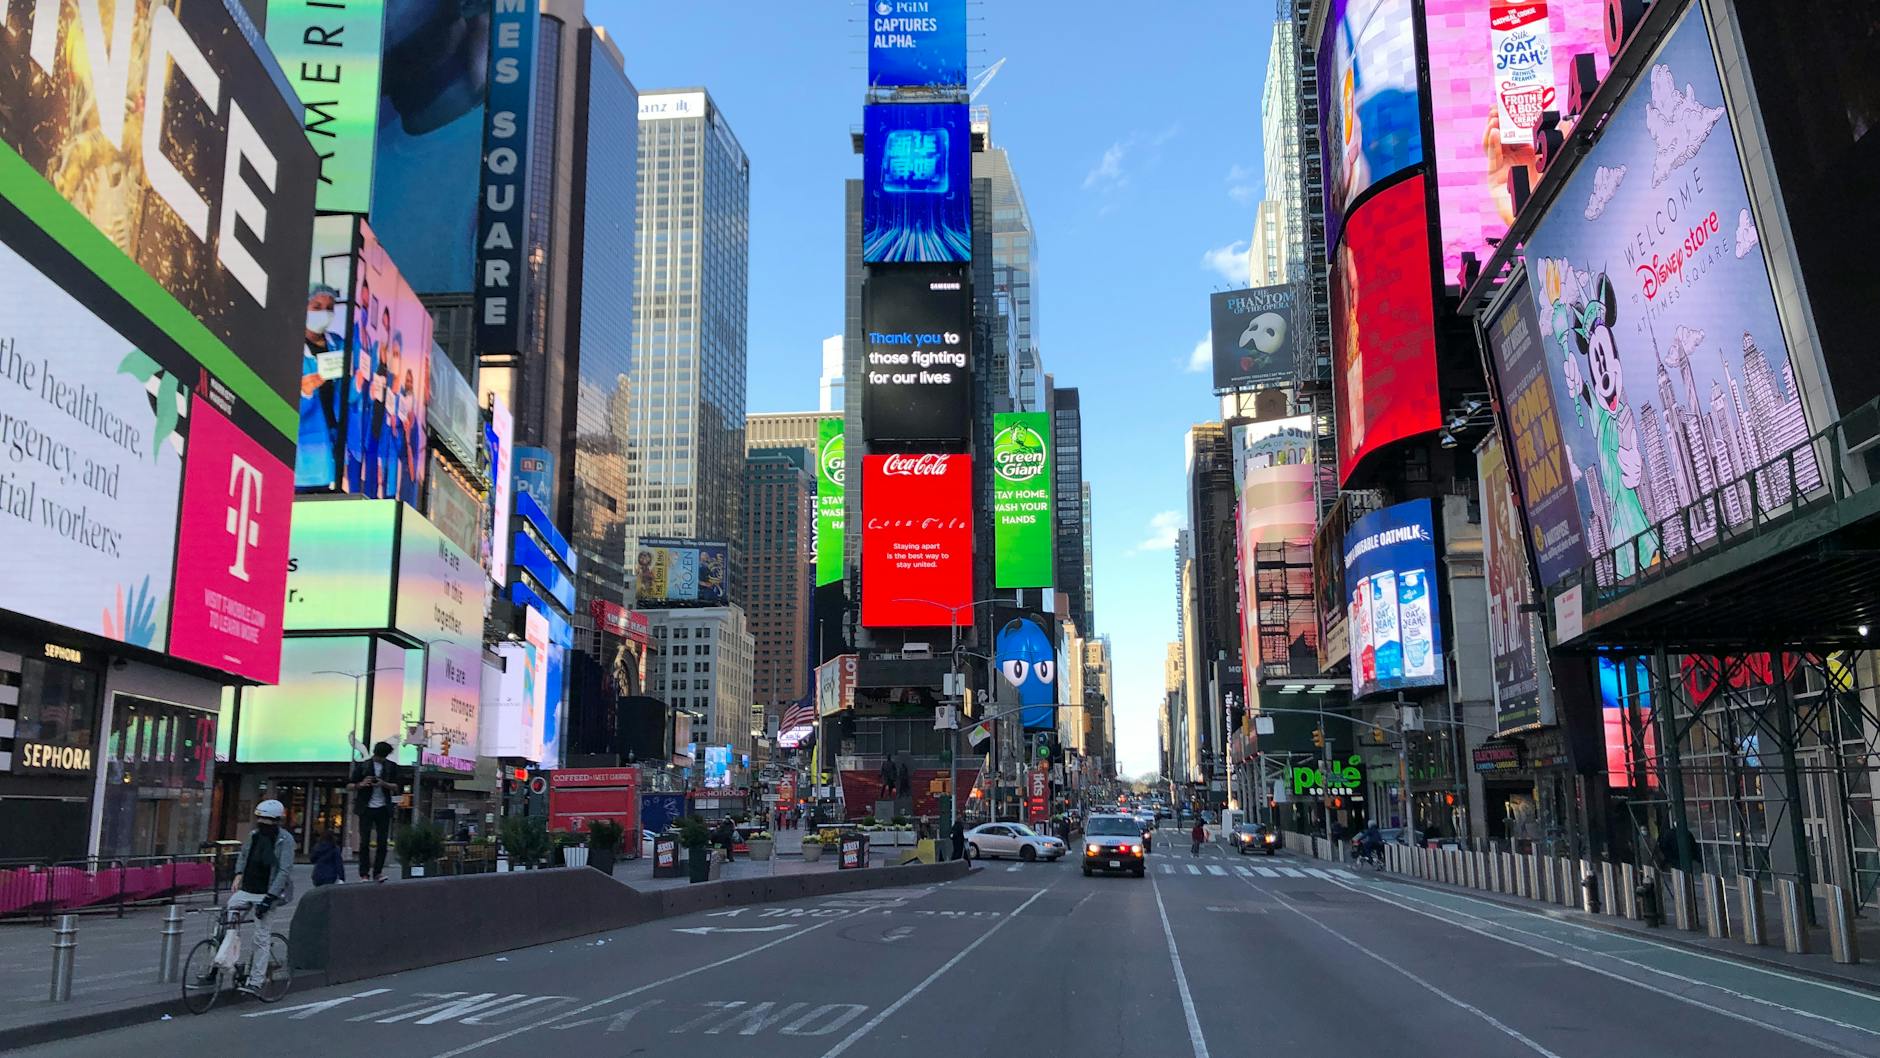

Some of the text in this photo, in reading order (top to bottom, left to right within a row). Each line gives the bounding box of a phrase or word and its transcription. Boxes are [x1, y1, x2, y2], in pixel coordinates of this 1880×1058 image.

[896, 1, 929, 13] PGIM
[874, 18, 937, 32] CAPTURES
[874, 35, 917, 48] ALPHA:
[1511, 30, 1529, 42] Silk
[1504, 35, 1537, 52] OAT
[1496, 50, 1543, 69] YEAH
[1504, 93, 1537, 106] FROTH
[1518, 103, 1543, 113] BOSS
[0, 0, 278, 309] NCE
[484, 111, 518, 325] SQUARE
[1624, 167, 1704, 267] WELCOME
[1684, 211, 1719, 258] store
[930, 282, 961, 290] SAMSUNG
[1651, 286, 1681, 320] TIMES
[1686, 238, 1729, 288] SQUARE
[1227, 292, 1296, 310] PHANTOM
[1263, 301, 1289, 310] OPERA
[869, 331, 960, 346] Thank you to
[869, 351, 966, 368] those fighting
[869, 371, 951, 385] for our lives
[41, 359, 143, 460] healthcare,
[0, 412, 120, 501] rgency, and
[997, 450, 1042, 463] Green
[883, 453, 950, 476] Coca-Cola
[1002, 463, 1044, 476] Giant
[1015, 489, 1048, 499] HOME,
[1020, 502, 1048, 511] YOUR
[1002, 515, 1036, 524] HANDS
[1380, 524, 1421, 546] OATMILK
[893, 542, 940, 551] Staying apart
[886, 552, 949, 561] is the best way to
[896, 561, 938, 569] stay united.
[679, 551, 693, 596] FROZEN
[44, 643, 82, 664] SEPHORA
[23, 743, 91, 771] SEPHORA
[1309, 787, 1353, 796] SOCER
